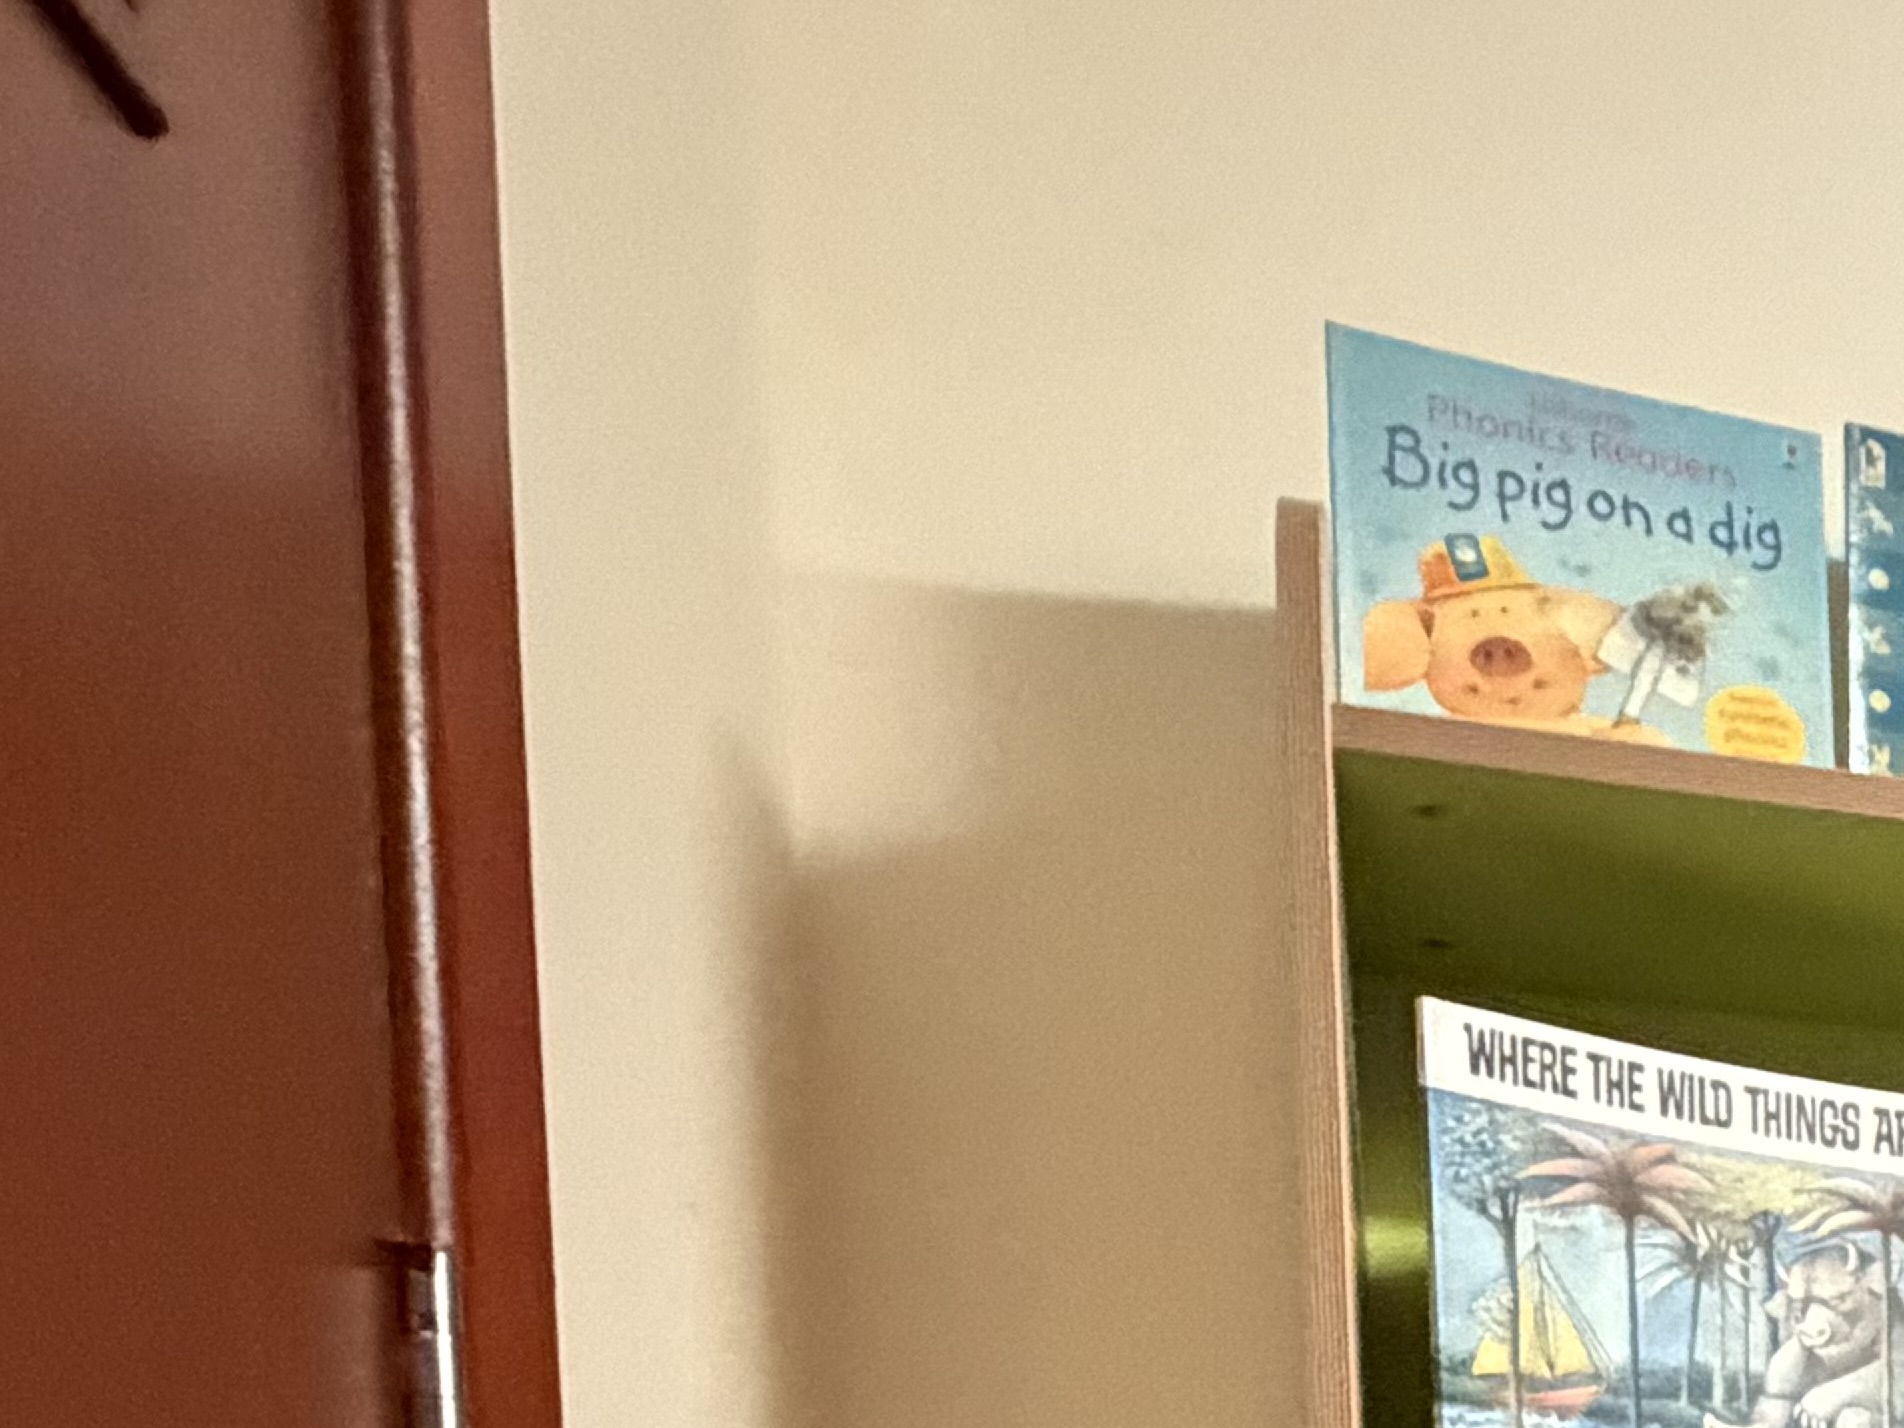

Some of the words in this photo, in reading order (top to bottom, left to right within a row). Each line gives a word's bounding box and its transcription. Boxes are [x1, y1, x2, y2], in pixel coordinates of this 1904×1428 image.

[1382, 424, 1480, 511] Big
[1497, 462, 1573, 531] pig
[1586, 489, 1653, 536] on
[1667, 506, 1693, 544] a
[1709, 501, 1782, 571] dig
[1427, 394, 1575, 454] Phonics
[1590, 430, 1737, 488] Readers
[1463, 1022, 1578, 1099] WHERE
[1586, 1051, 1645, 1113] THE
[1657, 1067, 1733, 1128] WILD
[1743, 1085, 1860, 1151] THINGS
